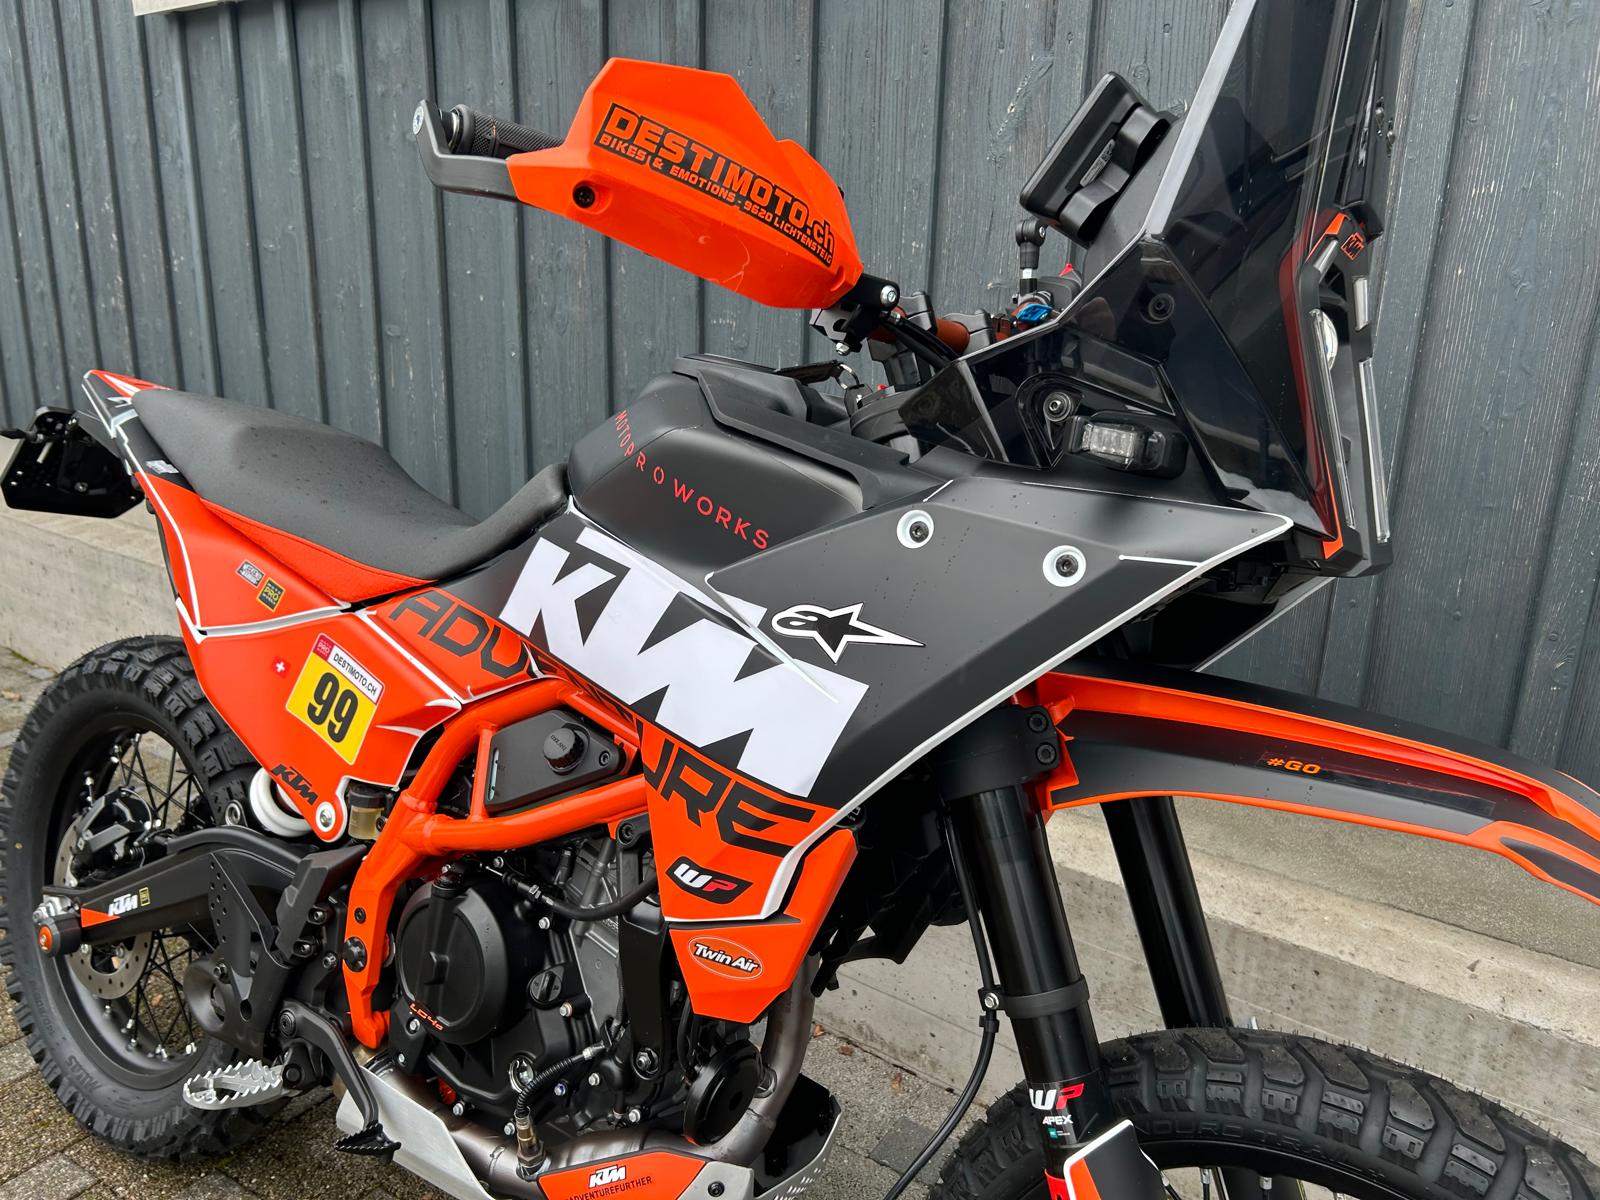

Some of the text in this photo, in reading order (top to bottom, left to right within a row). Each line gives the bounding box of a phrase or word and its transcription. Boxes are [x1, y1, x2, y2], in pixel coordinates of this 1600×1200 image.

[602, 105, 835, 251] DESTIMOTO.ch
[600, 133, 647, 161] BIKES
[652, 157, 664, 170] &
[670, 165, 736, 202] EMOTIONS
[744, 201, 773, 221] 9620
[774, 214, 833, 264] LICHTENSTEIG
[1340, 232, 1365, 261] KTM
[333, 652, 378, 696] DESTIMOTO.CH
[499, 527, 869, 798] KTM
[307, 672, 359, 744] 99
[1266, 757, 1321, 775] #GO
[271, 764, 320, 806] KTM
[673, 863, 738, 892] WP
[108, 893, 138, 917] KTM
[694, 942, 760, 973] Twin Air
[1028, 1082, 1085, 1111] WP
[1042, 1114, 1074, 1125] APEX
[566, 1175, 653, 1200] ADVENTUREFURTHER
[588, 1164, 627, 1189] KTM
